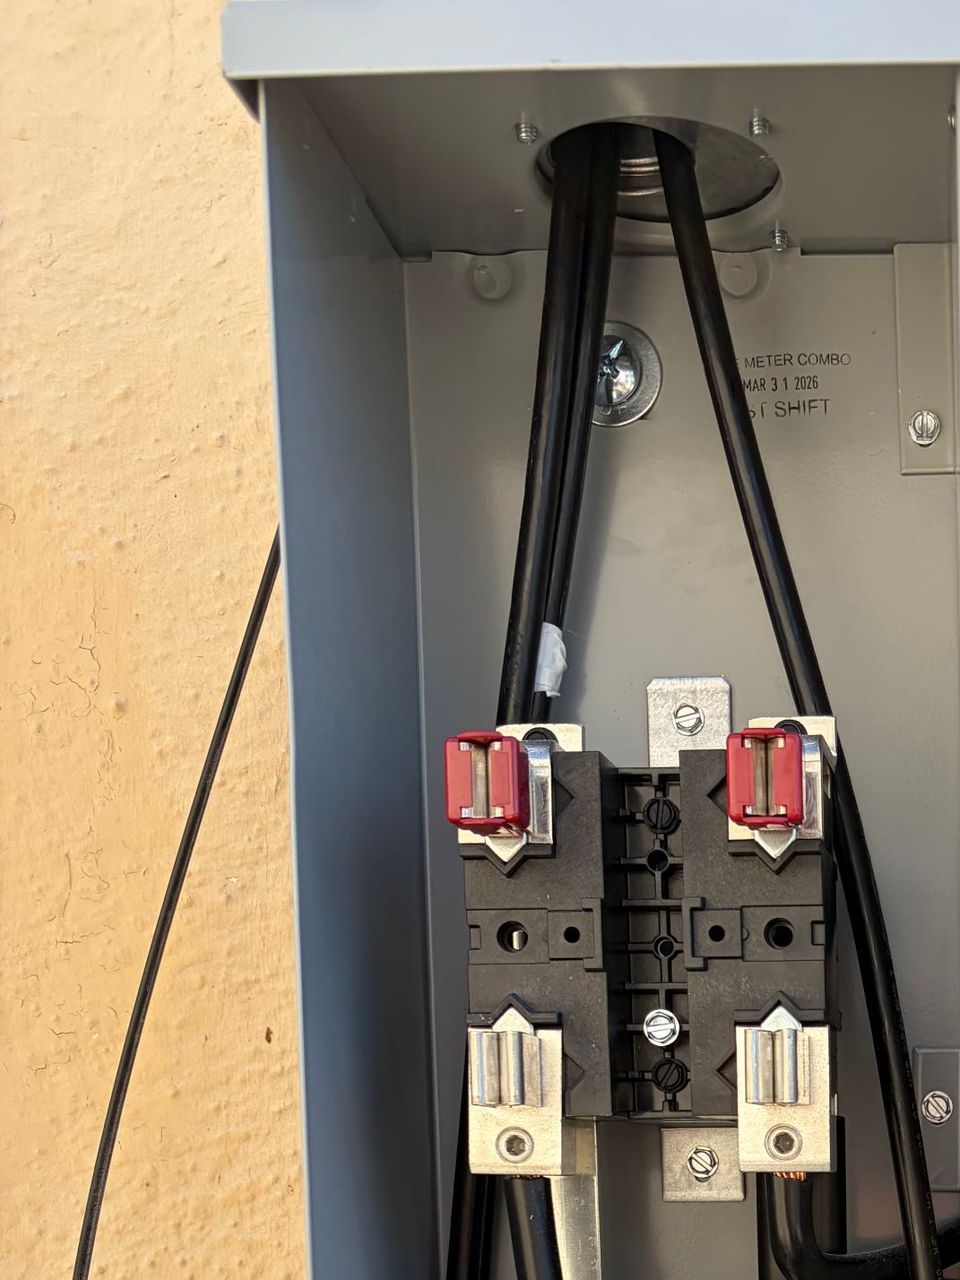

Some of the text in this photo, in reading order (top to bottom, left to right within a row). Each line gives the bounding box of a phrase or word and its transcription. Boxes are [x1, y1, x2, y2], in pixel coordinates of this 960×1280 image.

[744, 354, 794, 368] METER
[797, 353, 851, 366] COMBO
[743, 377, 767, 392] MAR
[795, 376, 819, 390] 2026
[775, 399, 831, 417] SHIFT
